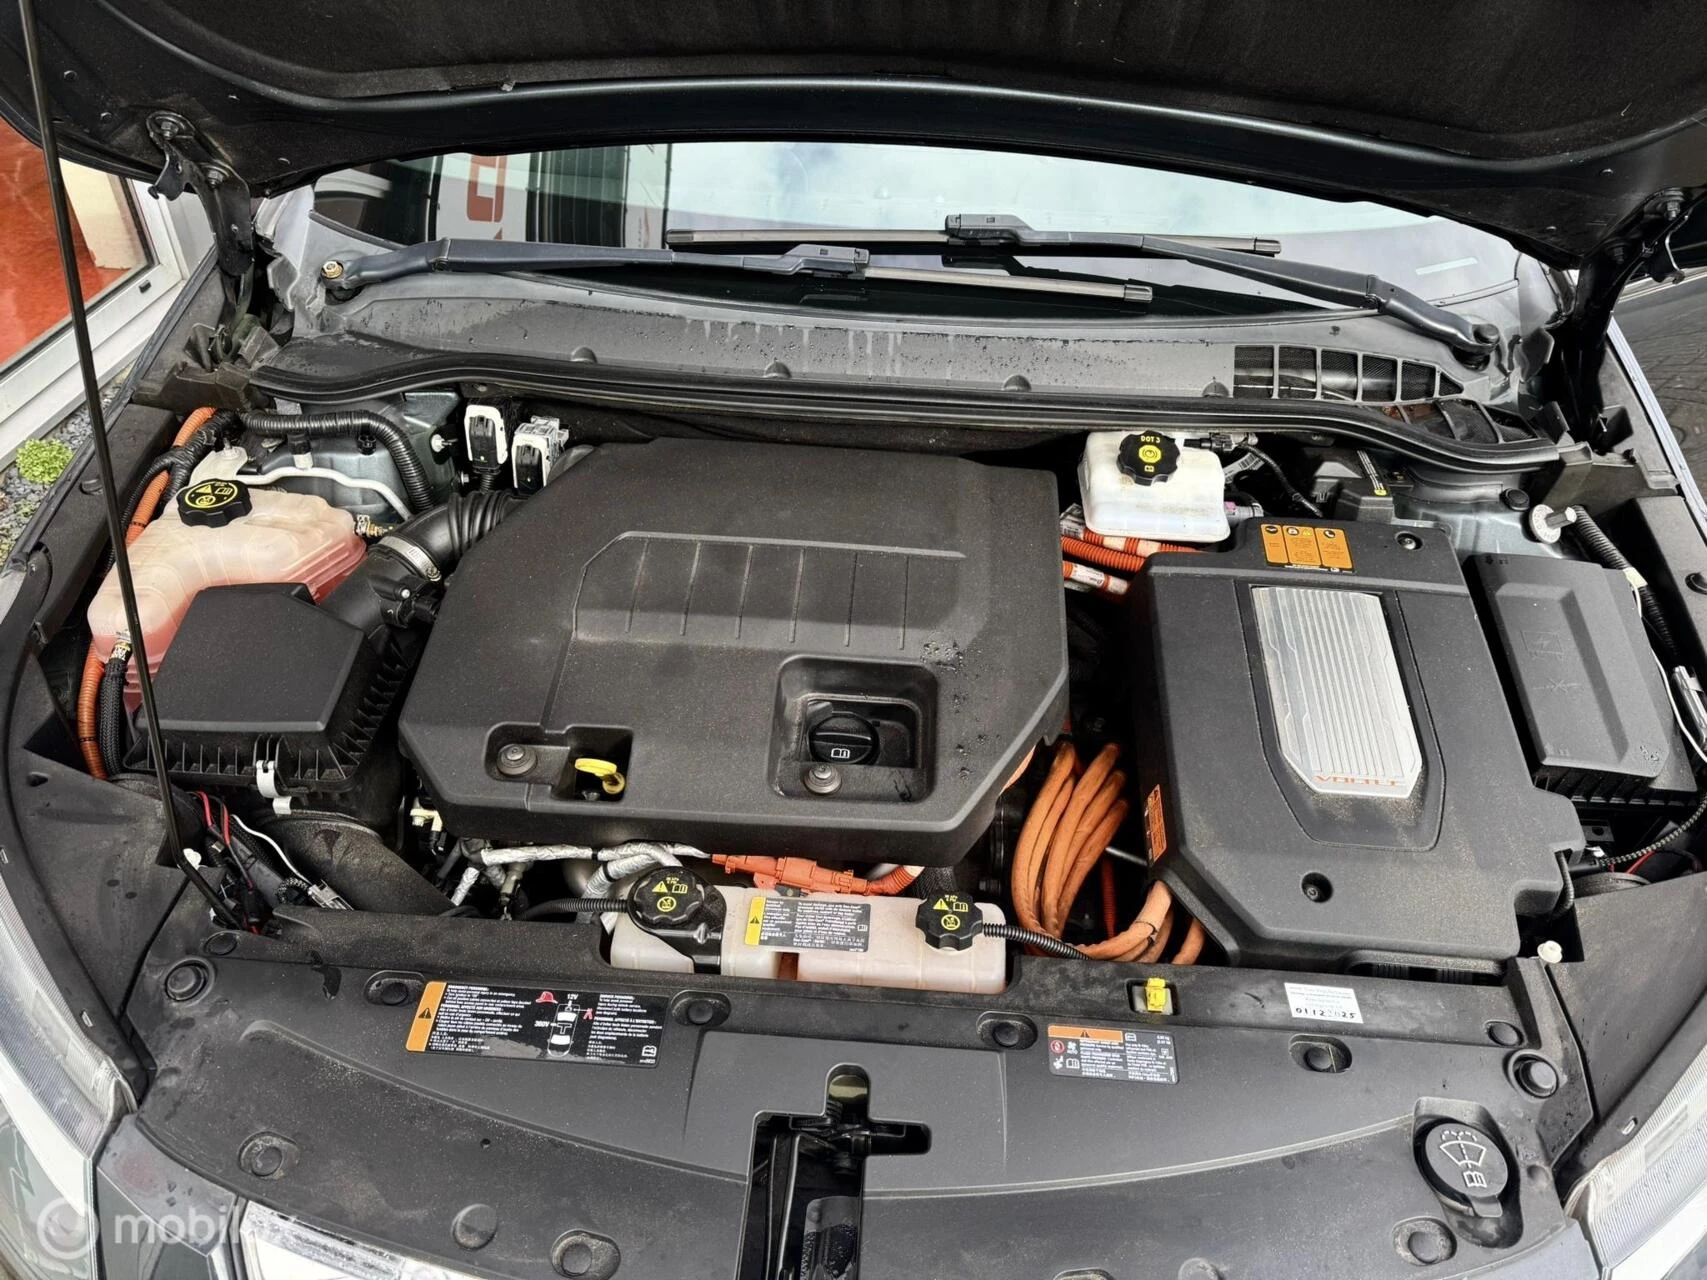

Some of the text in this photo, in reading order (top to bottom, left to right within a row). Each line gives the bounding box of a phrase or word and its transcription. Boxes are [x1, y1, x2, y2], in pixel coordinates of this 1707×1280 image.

[1140, 435, 1161, 444] DOT 3
[567, 993, 579, 1001] 12V
